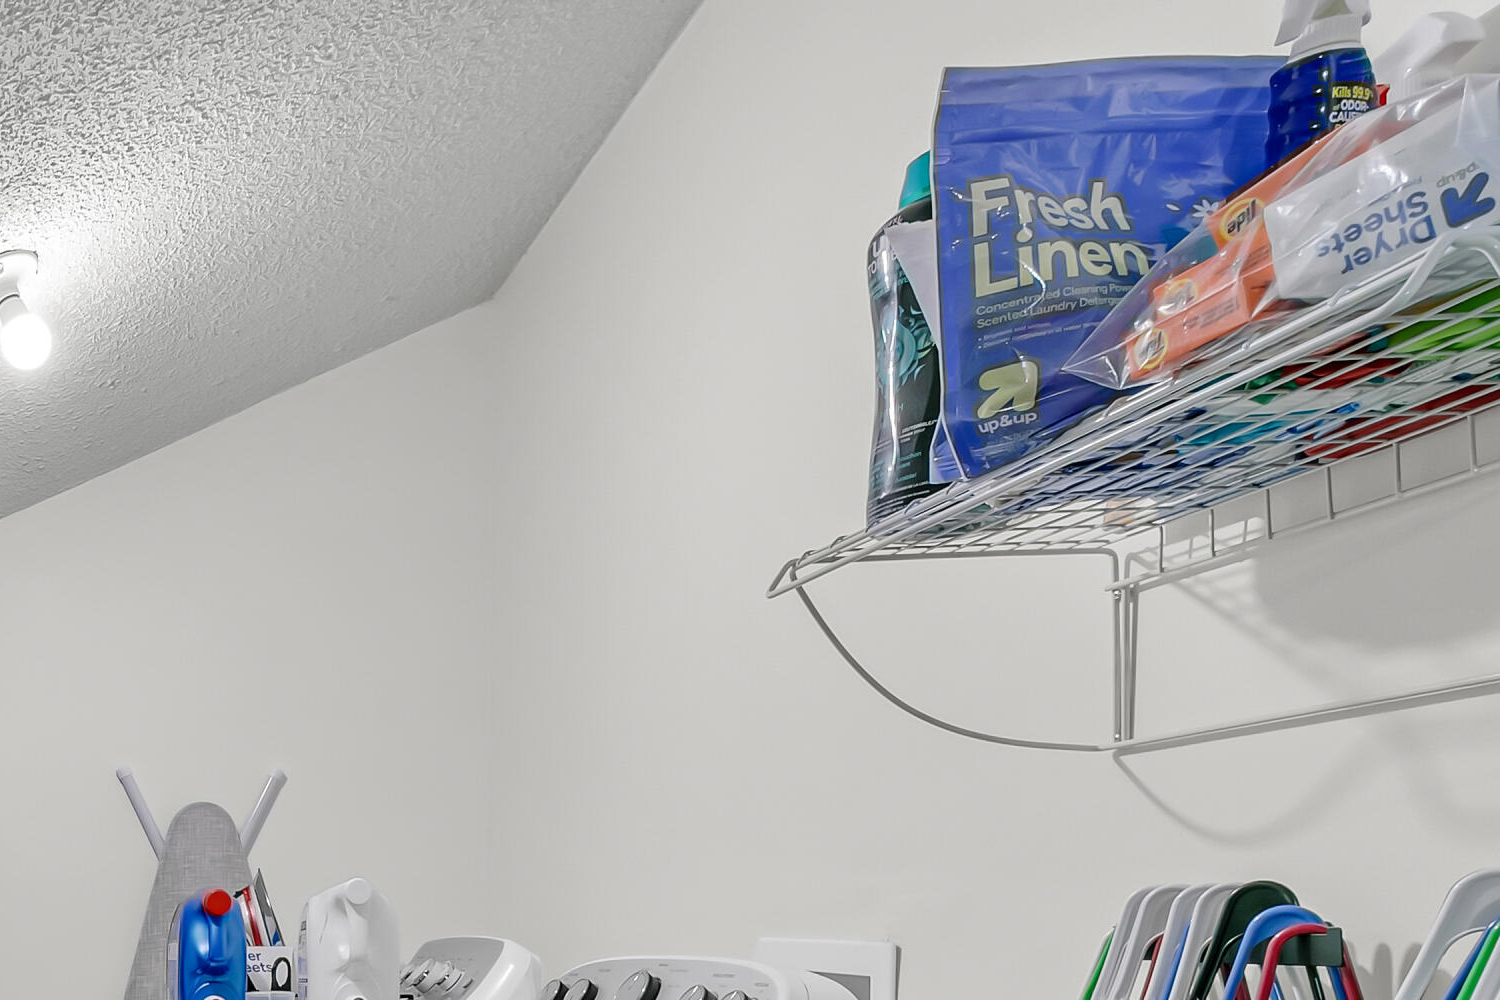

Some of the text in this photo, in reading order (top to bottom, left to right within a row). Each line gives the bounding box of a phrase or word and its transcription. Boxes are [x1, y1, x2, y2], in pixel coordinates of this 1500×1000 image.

[1332, 86, 1351, 98] Kills
[1436, 162, 1481, 188] p&up
[970, 177, 1131, 237] Fresh
[1316, 191, 1429, 257] Sheets
[1341, 215, 1437, 274] Dryer
[973, 226, 1150, 297] Linen
[1062, 285, 1108, 297] Cleaning
[976, 297, 1124, 329] Scented Laundry Deterge
[978, 412, 1038, 434] up&up
